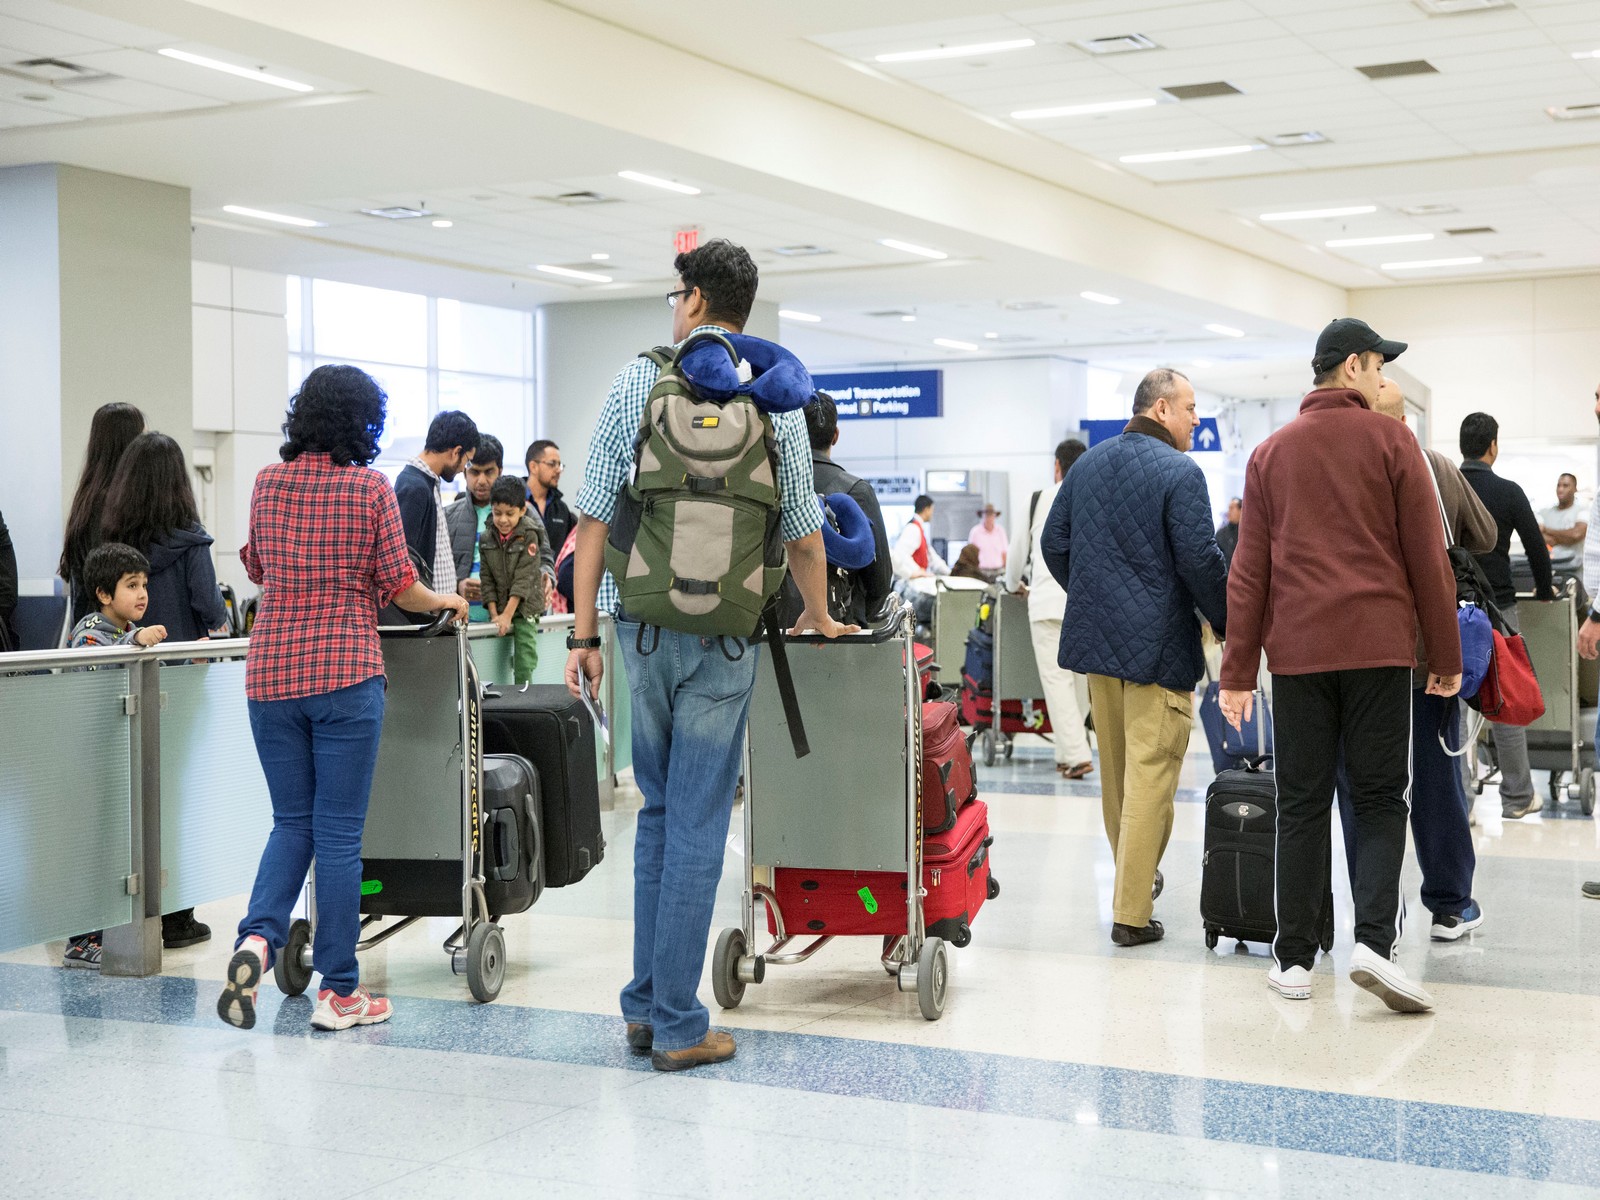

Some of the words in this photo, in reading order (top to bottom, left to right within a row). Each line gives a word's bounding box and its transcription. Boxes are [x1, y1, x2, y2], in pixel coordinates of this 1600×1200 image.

[677, 230, 699, 254] EXIT
[853, 385, 921, 401] Transportation
[873, 401, 909, 415] Parking
